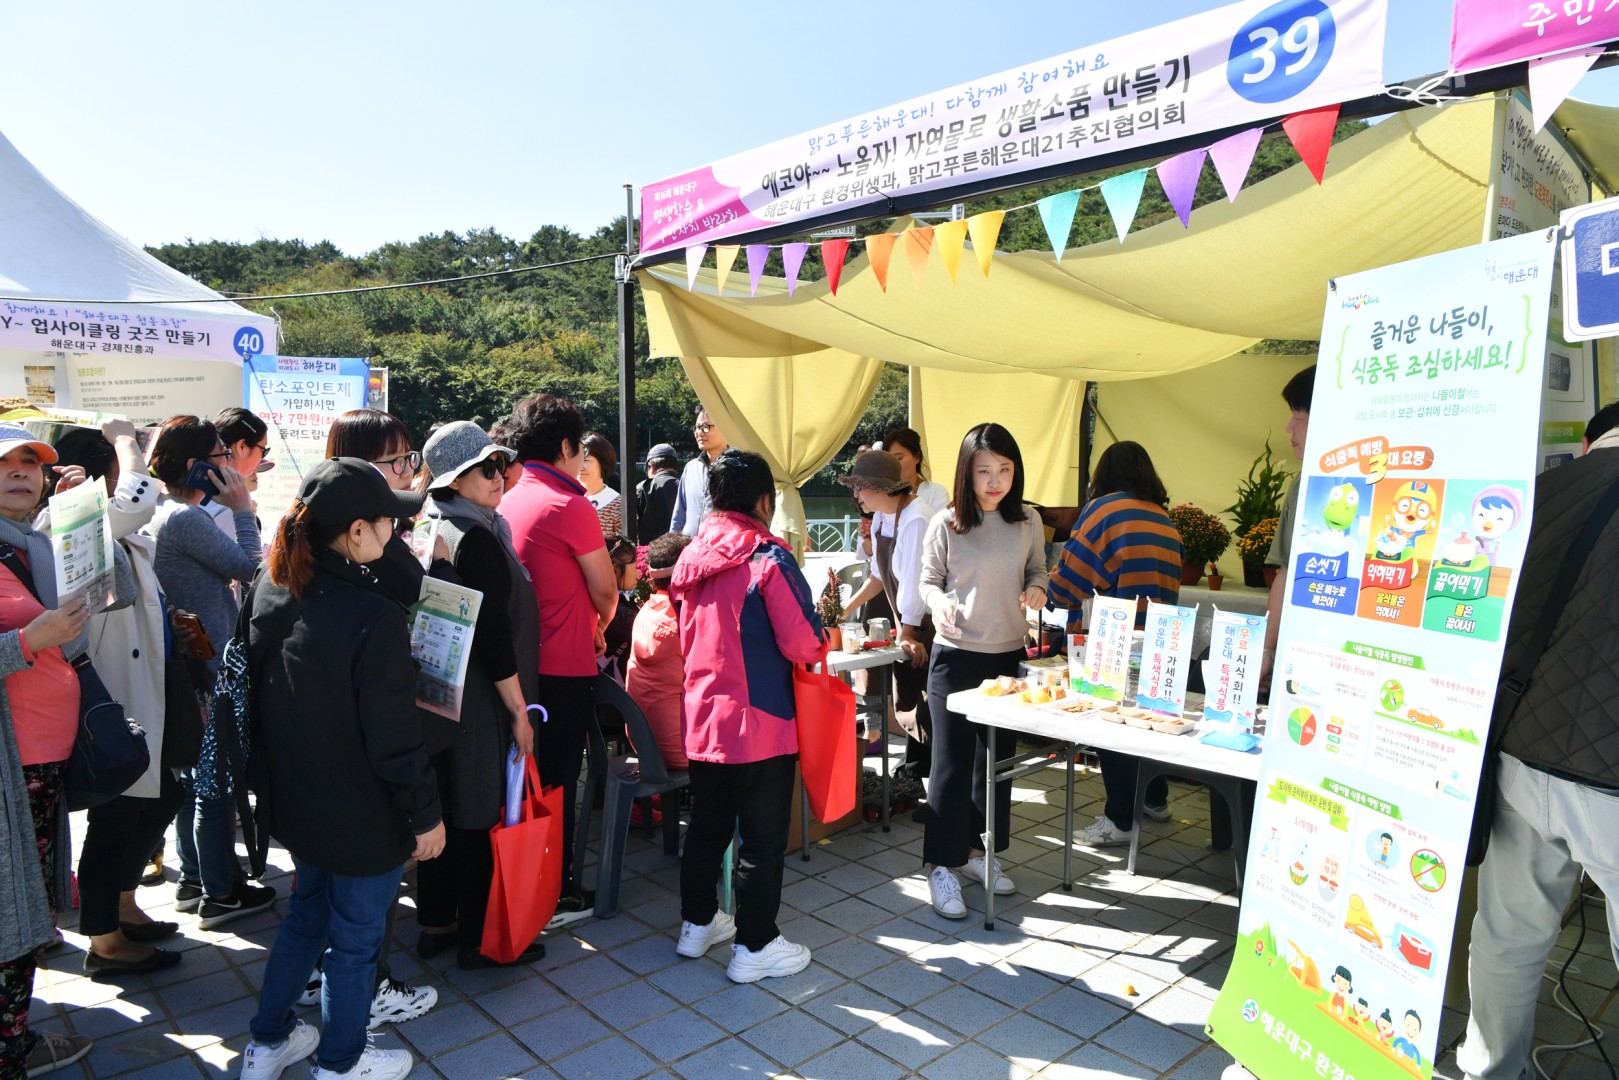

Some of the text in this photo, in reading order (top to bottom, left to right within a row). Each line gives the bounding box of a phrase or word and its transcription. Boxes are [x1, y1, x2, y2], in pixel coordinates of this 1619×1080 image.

[1522, 0, 1619, 36] 주민
[1242, 16, 1320, 84] 39
[808, 53, 1110, 156] 맑고푸른해운대! 다함께 참여해요
[836, 136, 897, 177] 노올자!
[904, 114, 987, 160] 자연물로
[994, 83, 1091, 138] 생활소품
[1103, 54, 1190, 111] 만들기
[764, 100, 1186, 218] 해운대구 환경위생과, 맑고푸른해운대21추진협의회
[703, 209, 738, 232] 박람회
[31, 318, 120, 340] 업사이클링
[128, 326, 160, 341] 굿즈
[166, 329, 210, 346] 만들기
[1370, 305, 1494, 350] 즐거운 나들이,
[51, 339, 97, 351] 해운대구
[102, 342, 154, 354] 경제진흥과
[238, 333, 260, 352] 40
[302, 360, 336, 373] 해운대
[1351, 352, 1400, 386] 식중독
[1405, 340, 1513, 379] 조심하세요!
[260, 379, 351, 398] 탄소포인트제
[283, 398, 335, 411] 가입하시면
[258, 412, 339, 426] 연간 7만원(최
[1325, 439, 1383, 467] 식중독 예방
[1401, 451, 1425, 466] 요령
[1305, 556, 1341, 577] 손씻기
[1367, 564, 1406, 586] 익혀먹기
[1308, 582, 1347, 597] 손은 비누로
[1433, 572, 1484, 597] 끓여먹기
[1376, 592, 1406, 608] 음식물은
[1097, 609, 1109, 638] 해운대
[1149, 617, 1168, 698] 해운대 특색식품
[1164, 619, 1183, 700] 맛보고 가세요!!
[1216, 626, 1235, 711] 해운대 특색식품
[1232, 628, 1250, 705] 무료 시식회!!
[1260, 1010, 1355, 1080] 해운대구 환경
